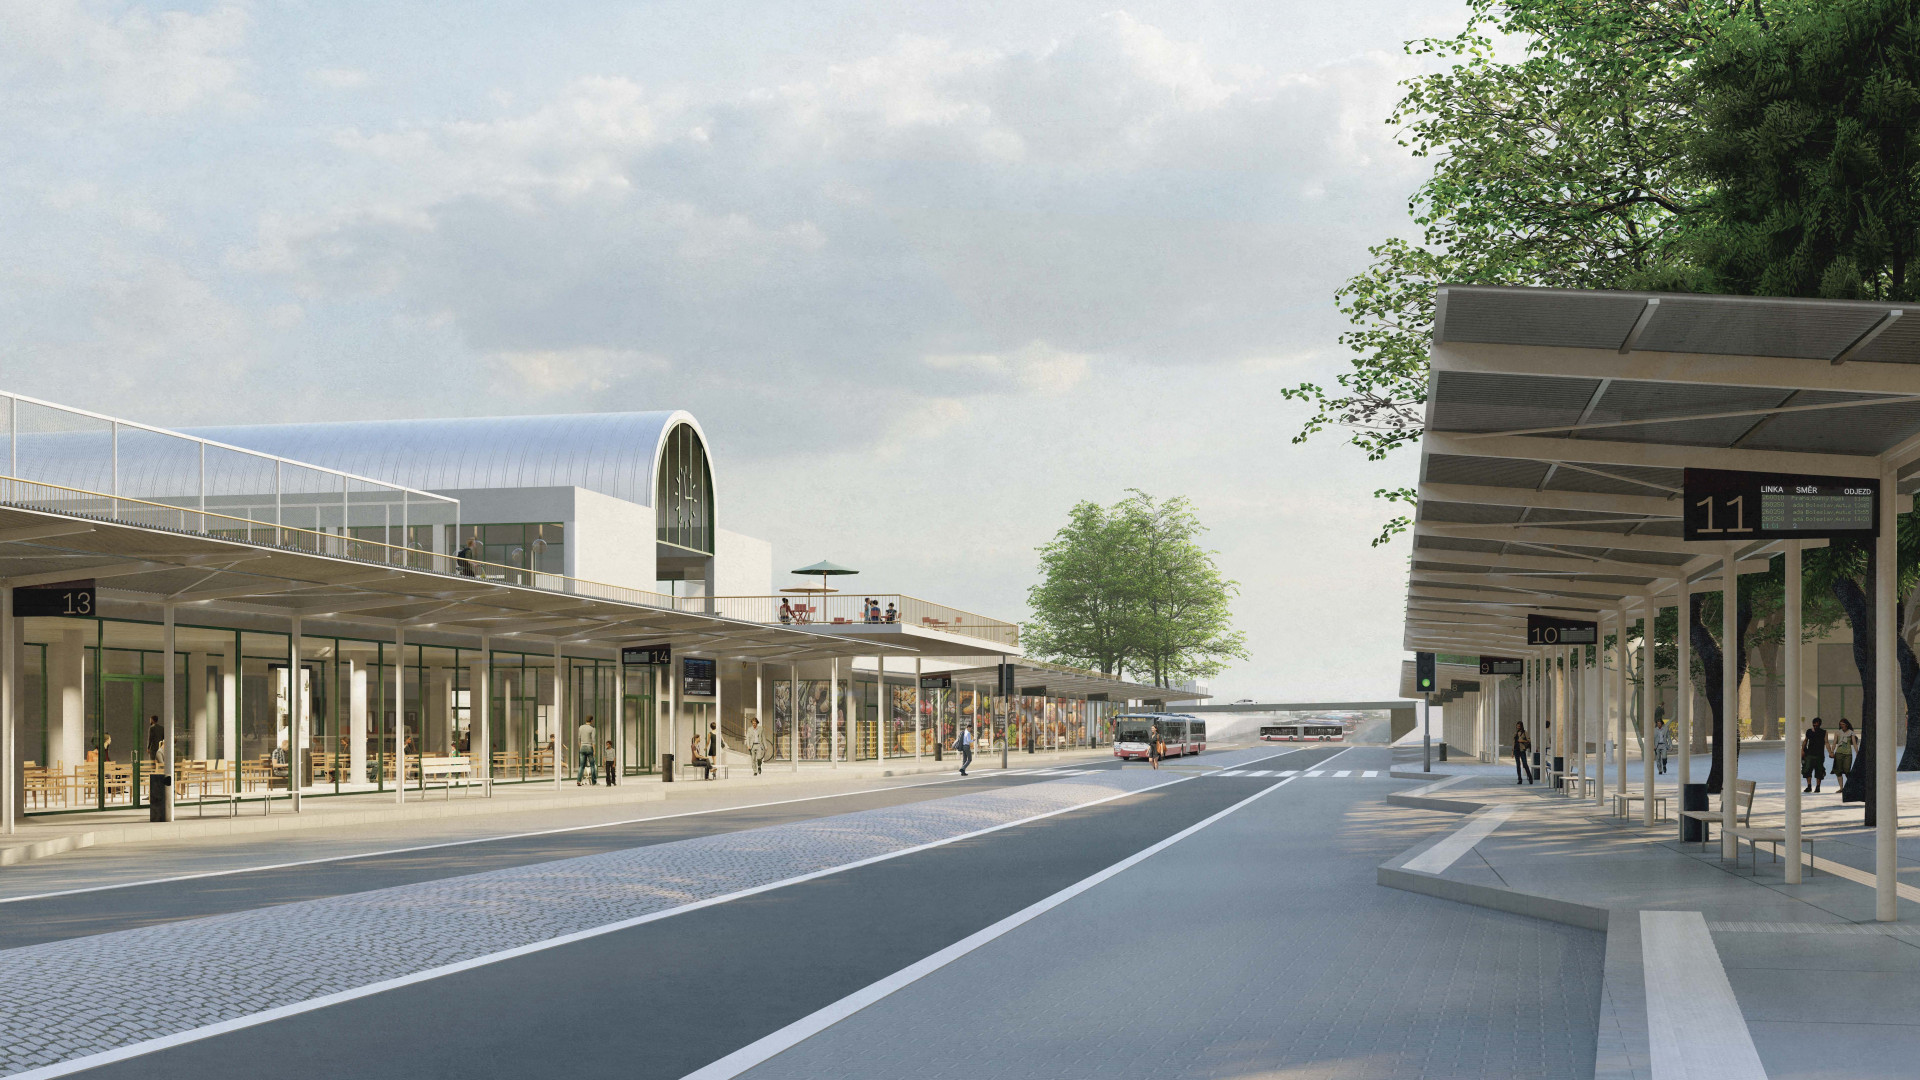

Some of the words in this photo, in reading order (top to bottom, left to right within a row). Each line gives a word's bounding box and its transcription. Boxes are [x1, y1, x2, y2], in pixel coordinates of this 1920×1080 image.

[1796, 485, 1818, 494] SMĚR
[1696, 496, 1753, 532] 11
[63, 592, 91, 614] 13
[1532, 627, 1558, 644] 10
[652, 651, 669, 664] 14
[1482, 663, 1490, 674] 9
